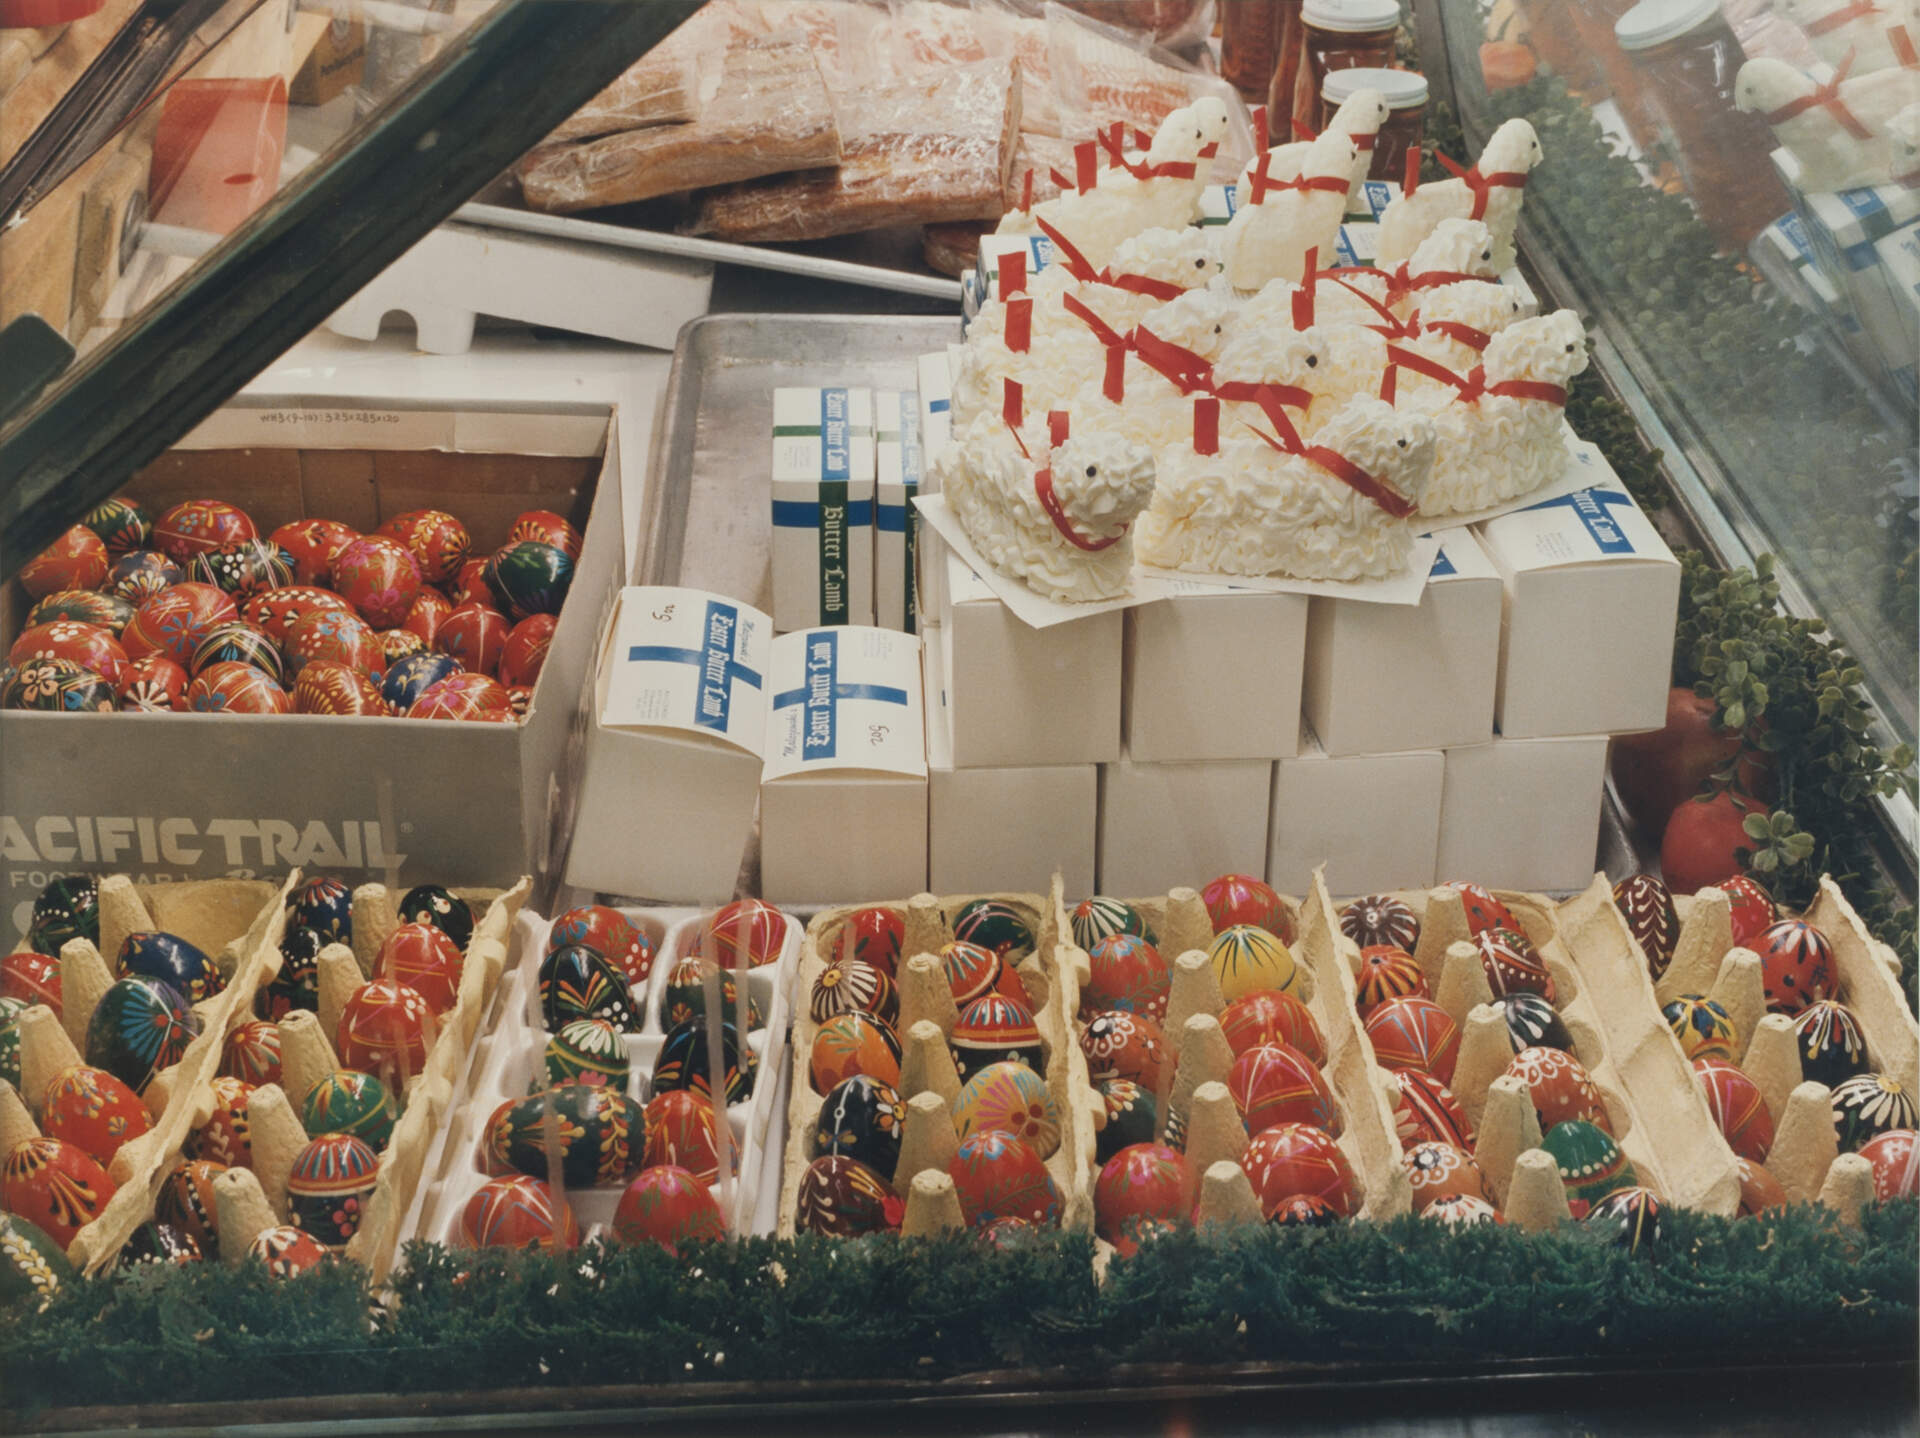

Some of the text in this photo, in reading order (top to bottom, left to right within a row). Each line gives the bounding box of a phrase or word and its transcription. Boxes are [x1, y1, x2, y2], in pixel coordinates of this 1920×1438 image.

[827, 392, 847, 471] Easter Butter Lamb
[823, 505, 845, 612] Butter Lamb
[1572, 489, 1601, 514] utter
[1587, 515, 1624, 543] Lamb
[702, 612, 734, 718] Easter Butter Lamb
[806, 641, 832, 748] Easter Butter Lamb
[204, 818, 409, 869] TRAIL
